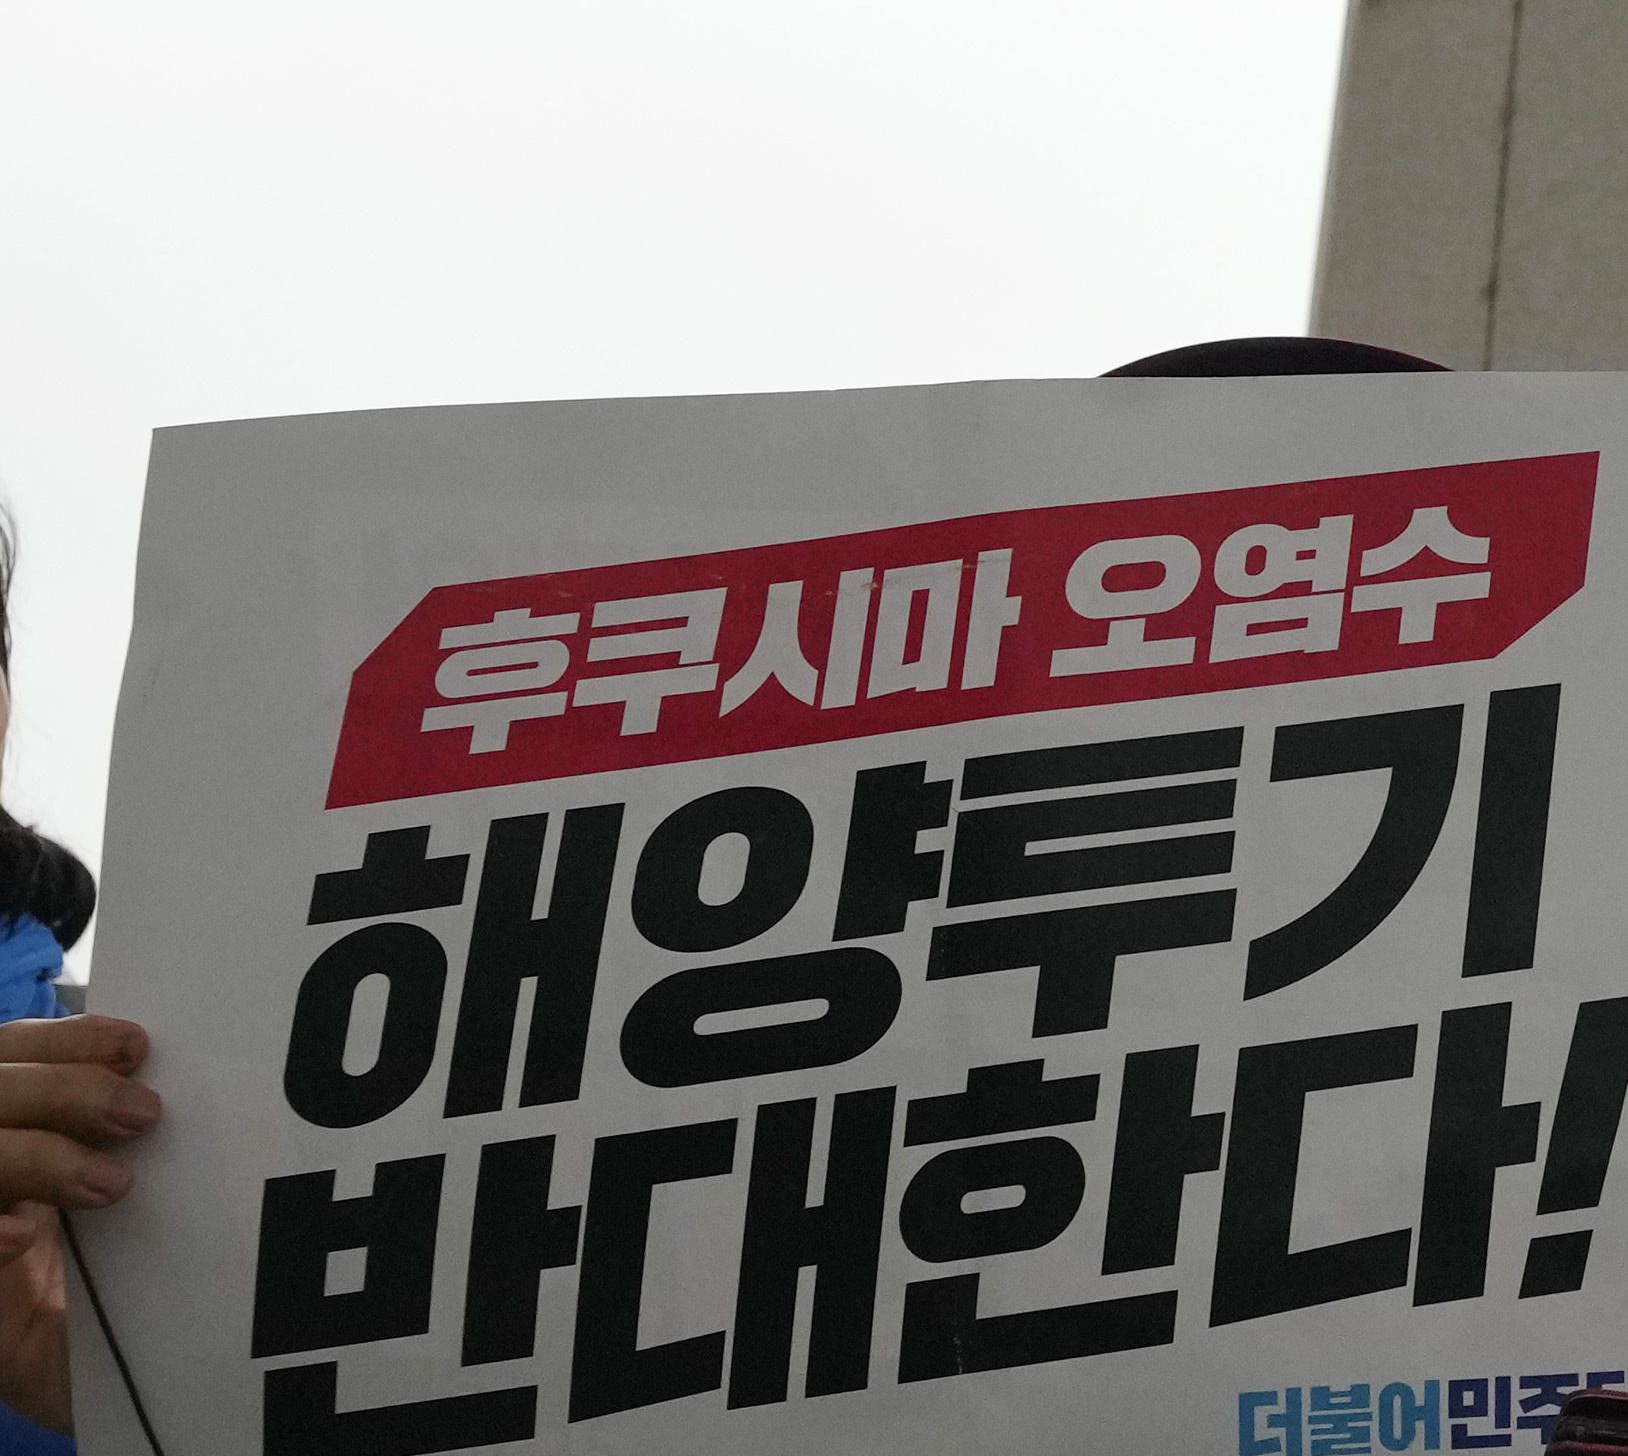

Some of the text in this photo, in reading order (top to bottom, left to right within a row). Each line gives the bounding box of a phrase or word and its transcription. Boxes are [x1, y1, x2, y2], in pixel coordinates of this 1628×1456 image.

[420, 504, 1500, 757] 후쿠시마 오염수
[282, 682, 1563, 1129] 해양투기
